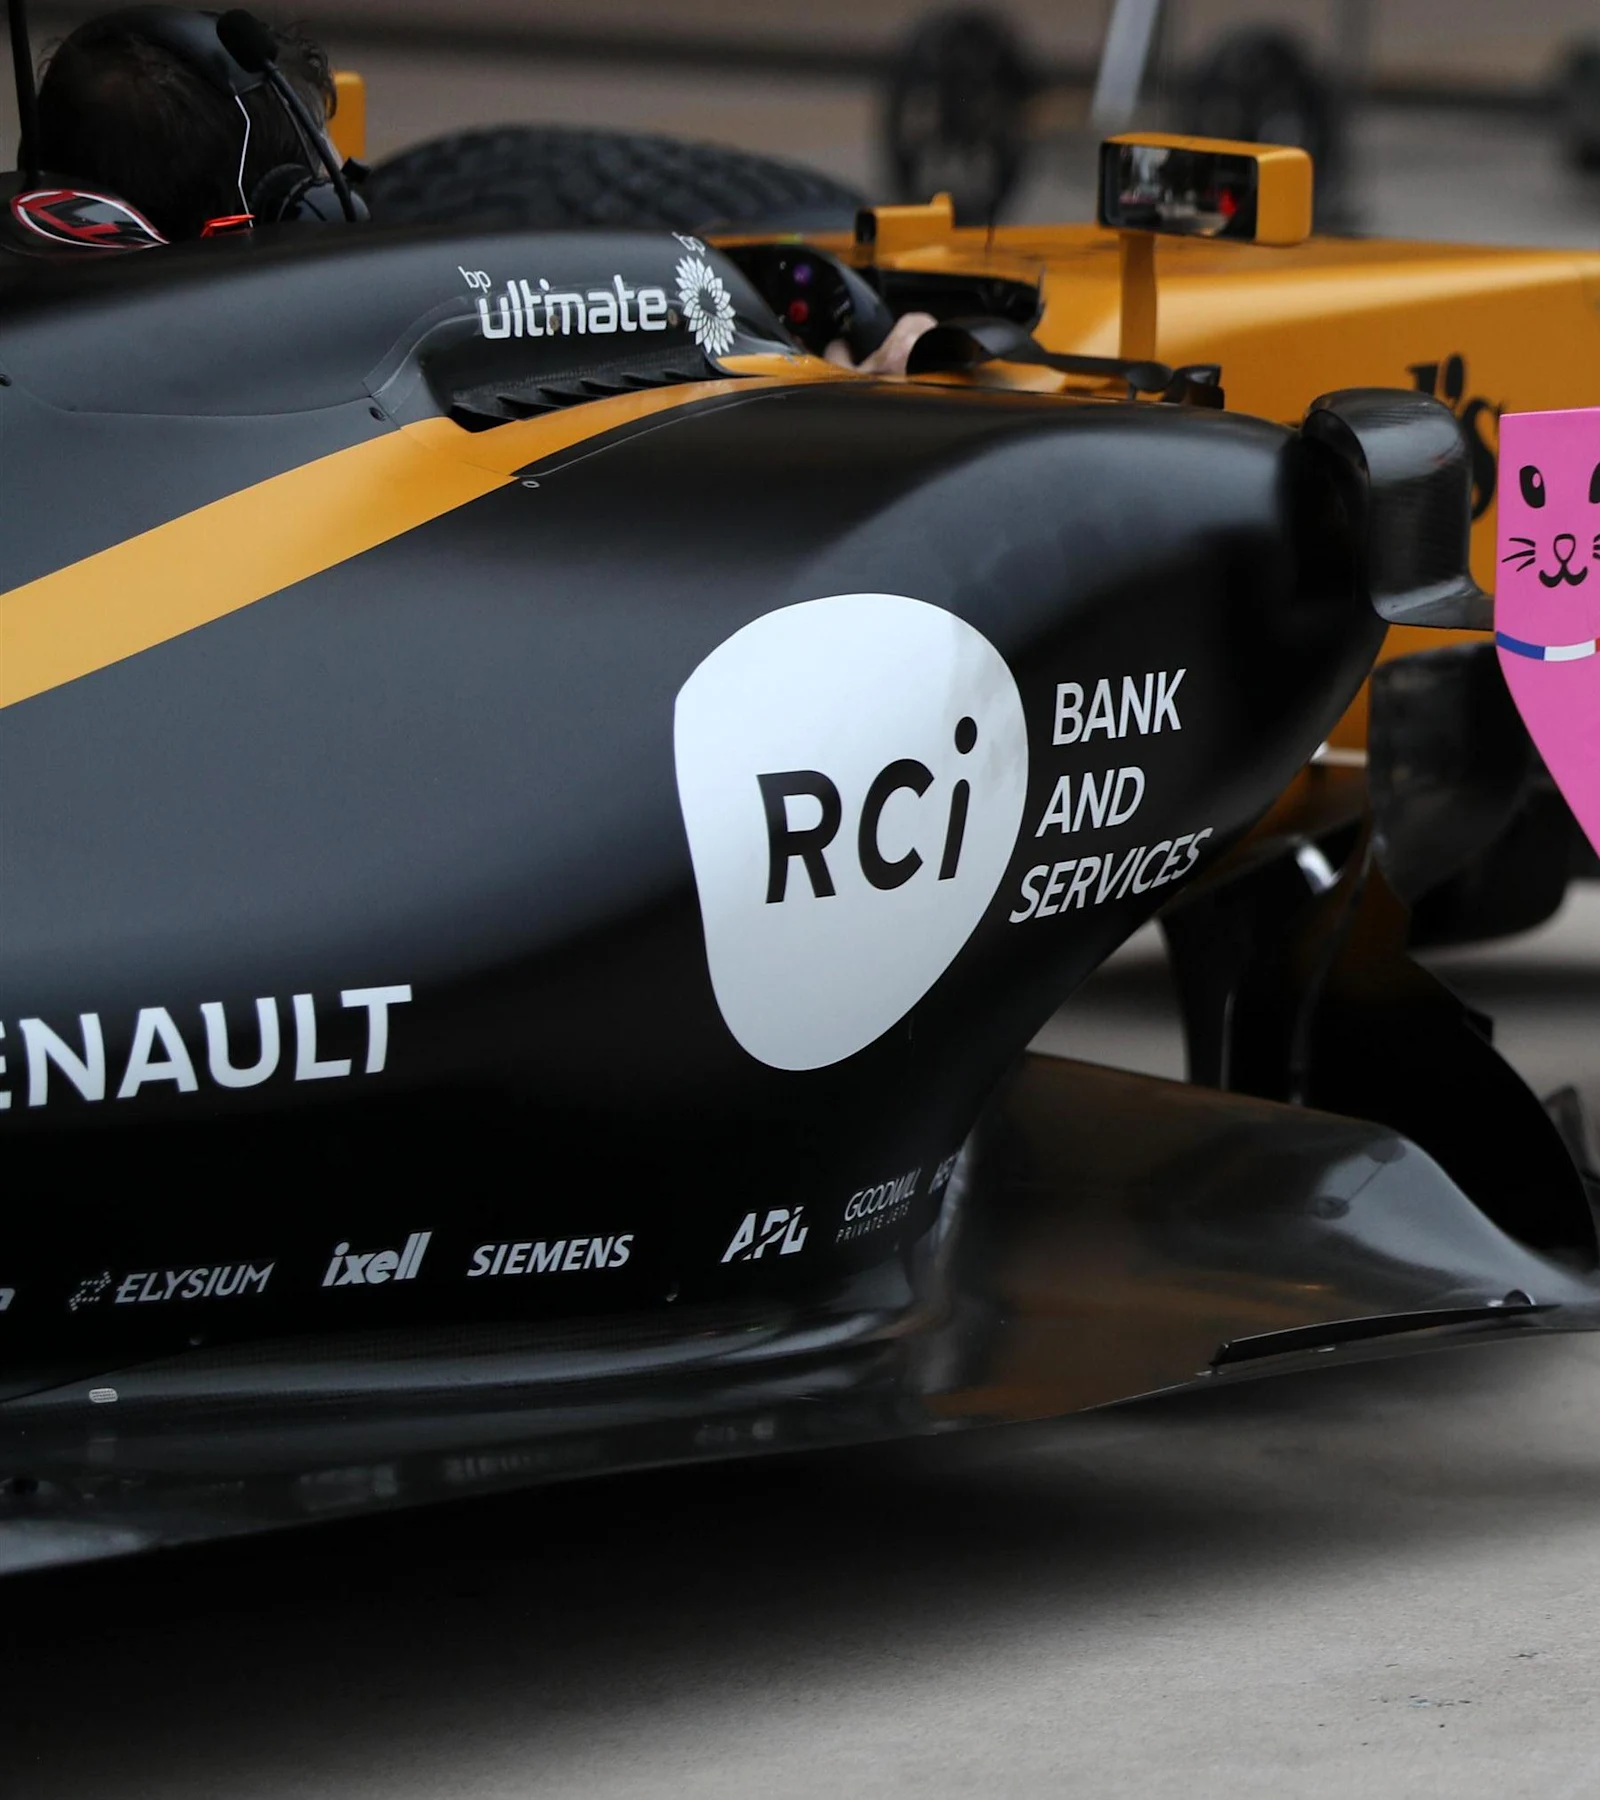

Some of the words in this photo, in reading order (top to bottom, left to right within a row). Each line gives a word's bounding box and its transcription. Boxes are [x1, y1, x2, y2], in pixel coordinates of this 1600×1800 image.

[457, 266, 492, 293] bp
[478, 274, 668, 339] ultimate
[1052, 668, 1187, 746] BANK
[1034, 766, 1146, 838] AND
[1008, 827, 1214, 924] SERVICES
[0, 984, 413, 1110] NAULT
[844, 1167, 922, 1222] GOODWILL
[114, 1262, 275, 1304] ELYSIUM
[321, 1231, 432, 1287] ixell
[467, 1234, 634, 1277] SIEMENS
